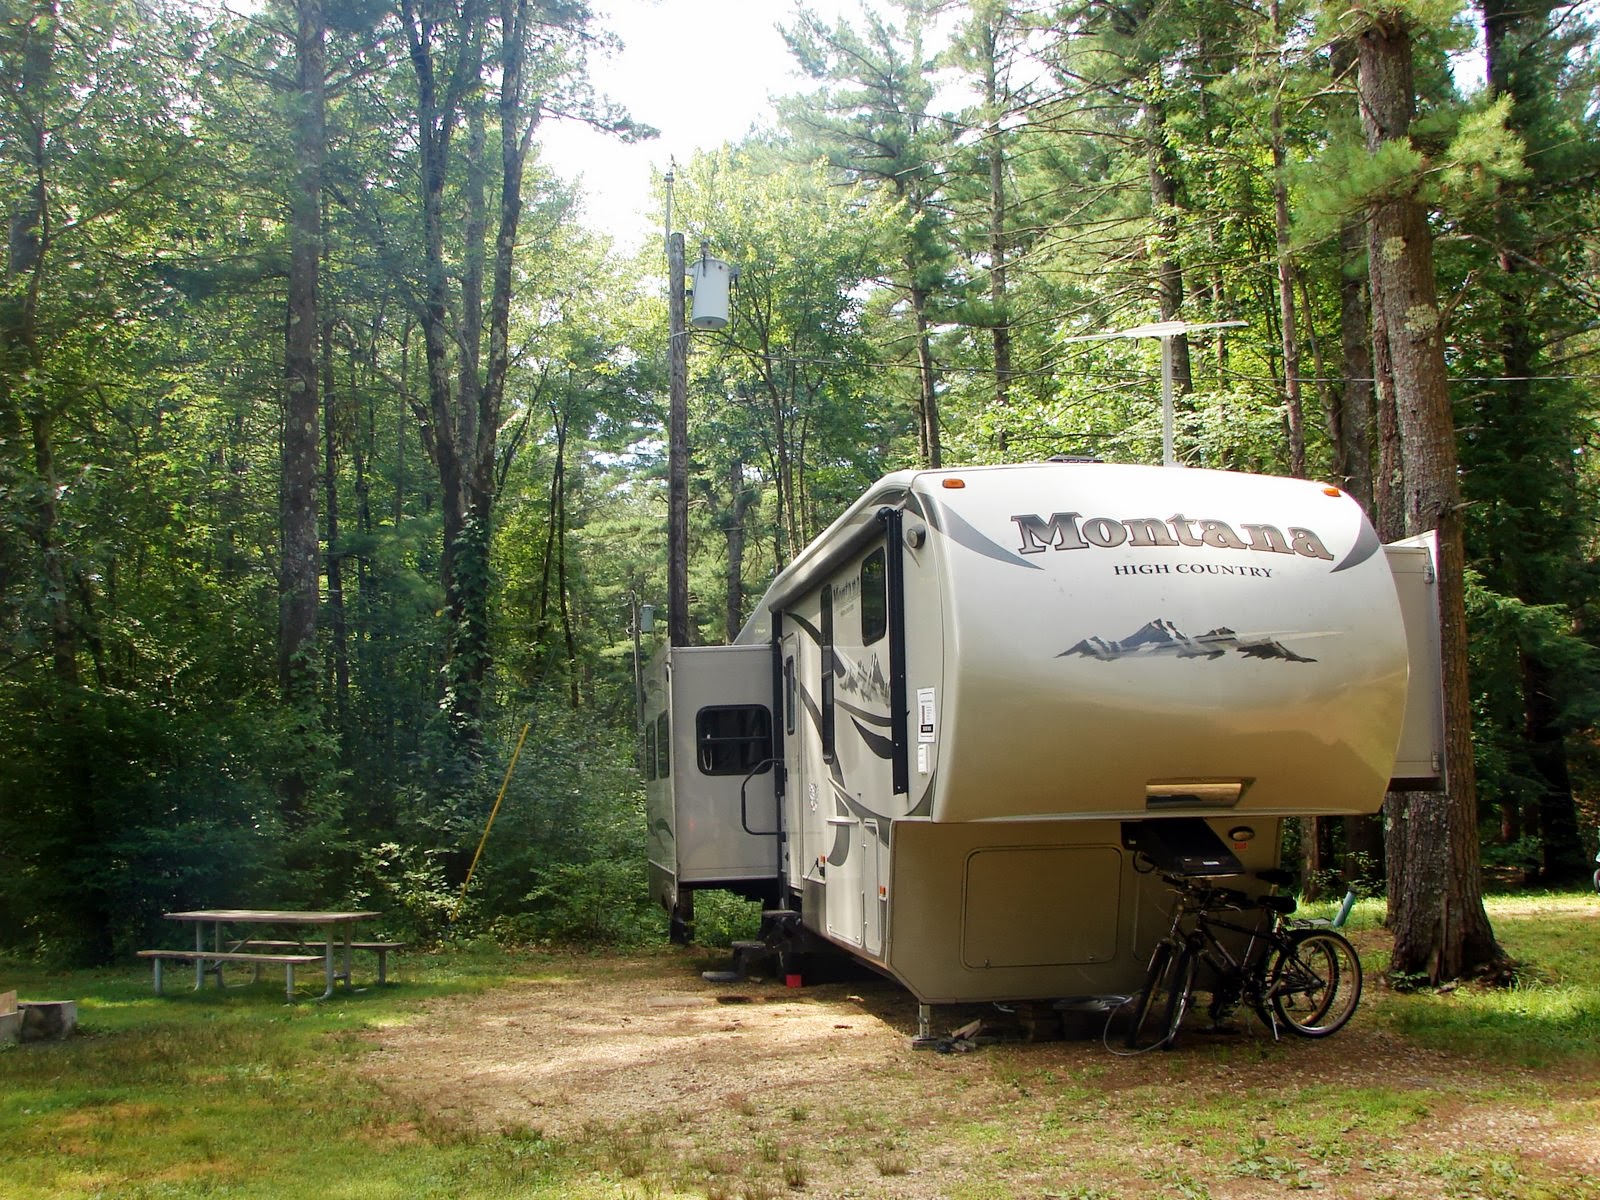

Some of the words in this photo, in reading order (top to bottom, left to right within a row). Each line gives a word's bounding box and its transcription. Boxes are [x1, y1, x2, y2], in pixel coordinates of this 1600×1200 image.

[1011, 511, 1335, 561] Montana
[1114, 564, 1171, 576] HIGH
[1175, 563, 1273, 578] COUNTRY
